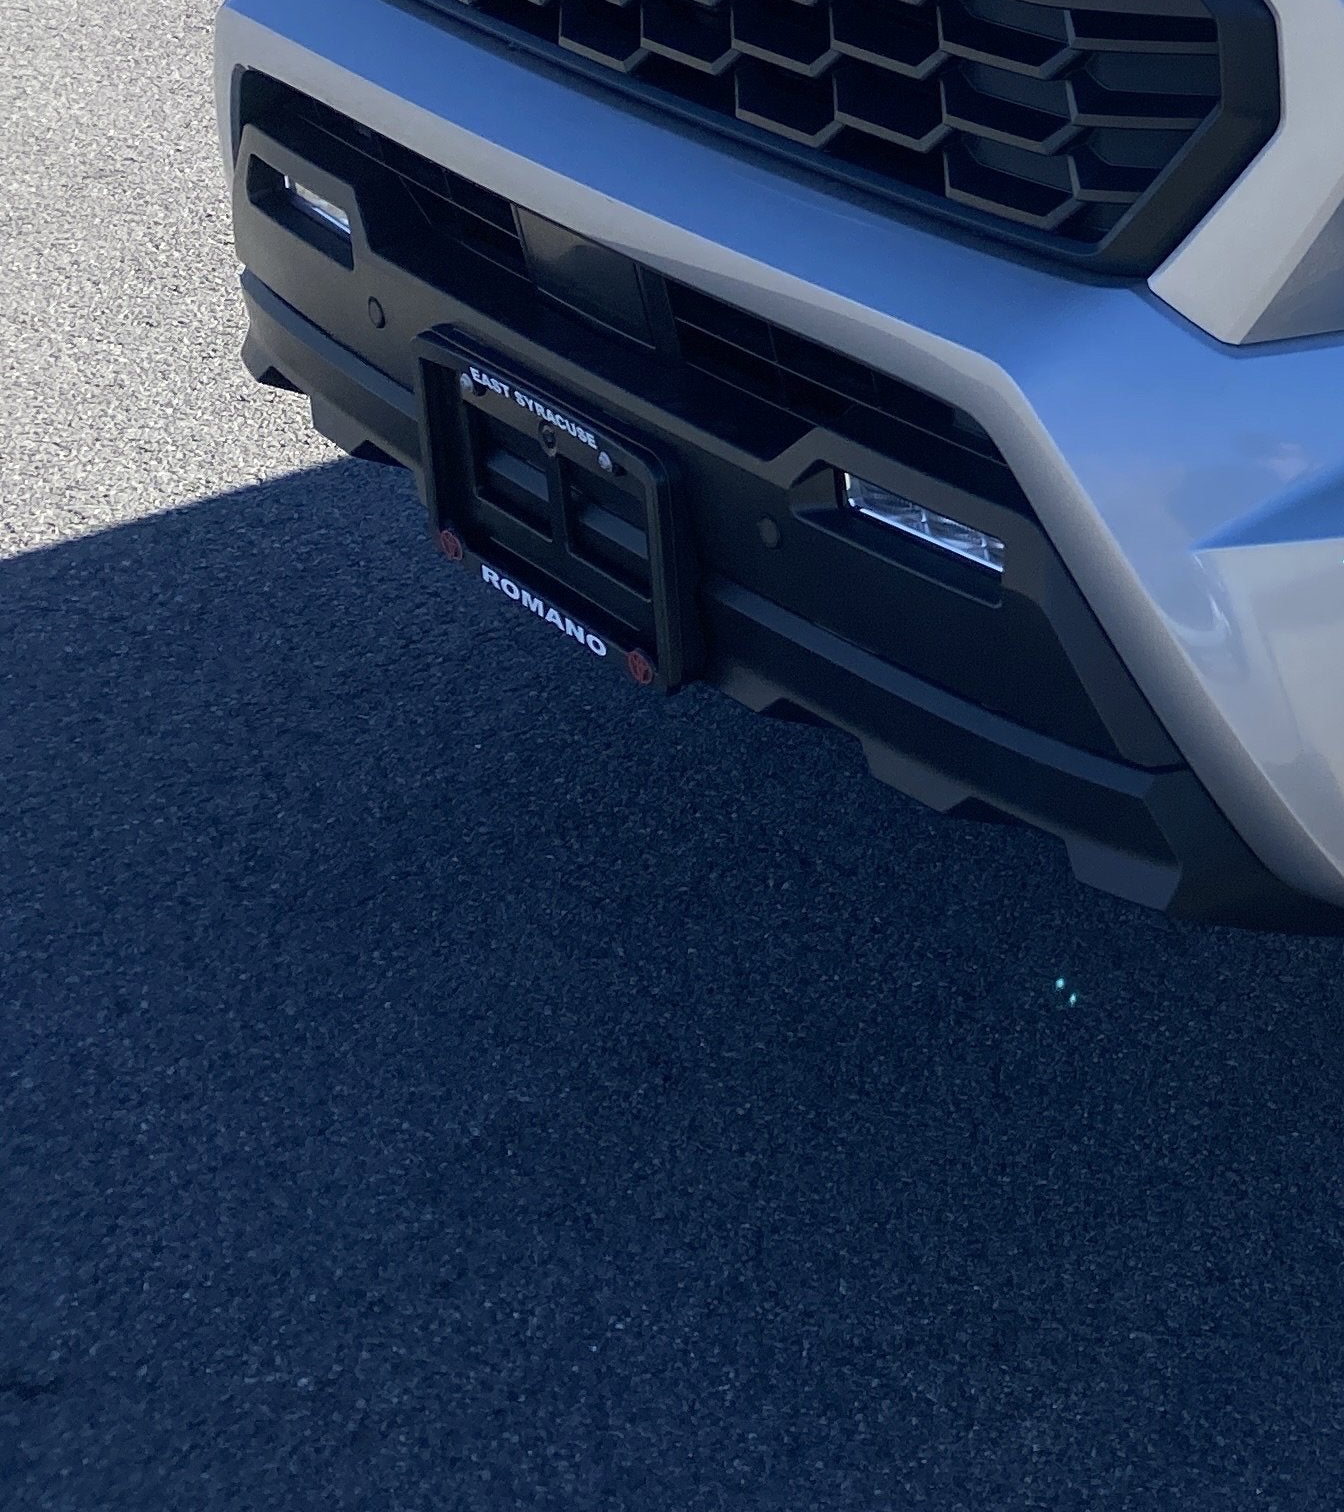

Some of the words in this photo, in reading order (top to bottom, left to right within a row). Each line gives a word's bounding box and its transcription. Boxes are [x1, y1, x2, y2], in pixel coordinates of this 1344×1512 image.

[469, 366, 510, 399] EAST
[514, 390, 598, 450] SYRACUSE
[481, 564, 607, 657] ROMANO
